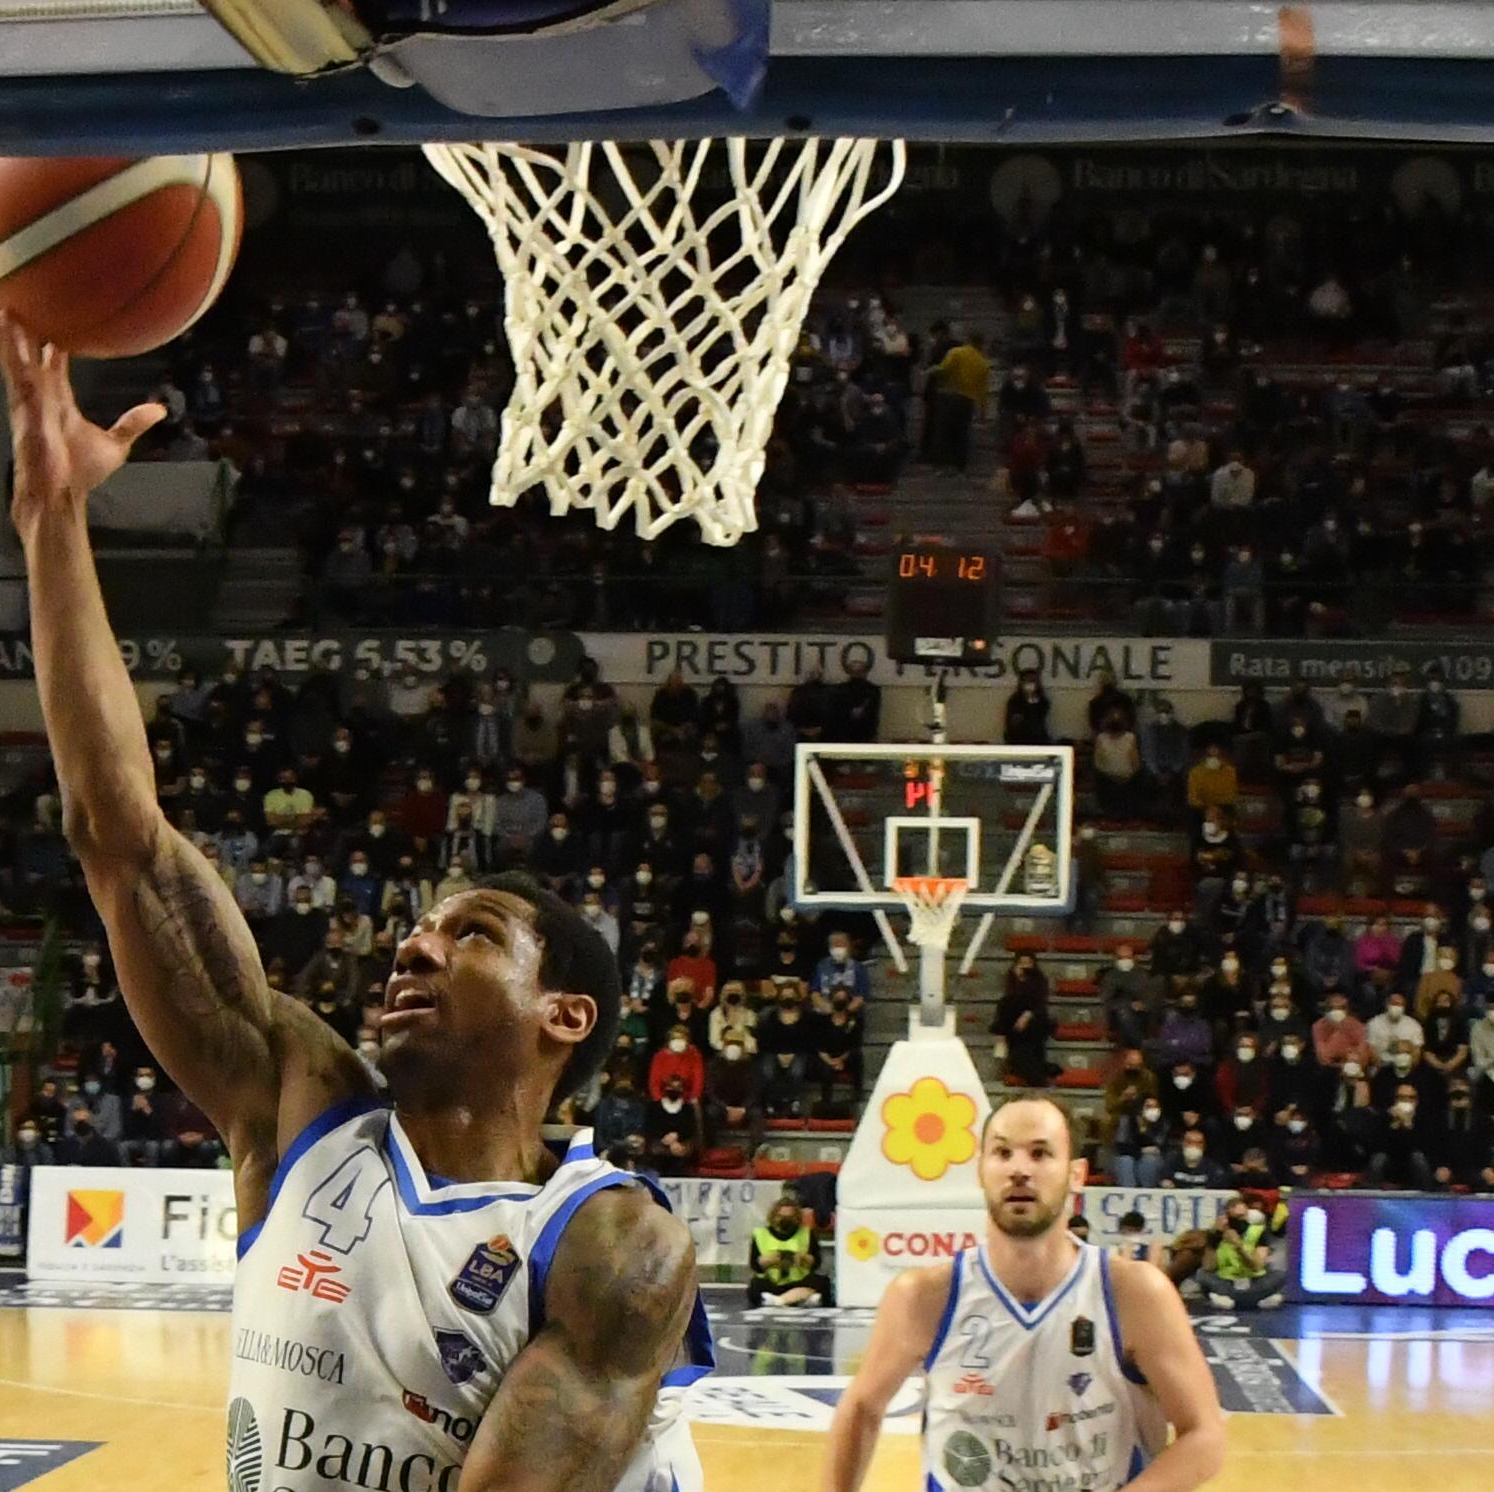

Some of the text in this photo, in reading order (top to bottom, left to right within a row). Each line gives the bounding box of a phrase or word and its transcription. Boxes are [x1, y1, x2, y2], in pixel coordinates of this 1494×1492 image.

[898, 553, 985, 580] 04 12
[119, 641, 183, 672] 9%
[224, 640, 342, 671] TAEG
[645, 640, 875, 678] PRESTITO
[893, 642, 1173, 683] SONALE
[1229, 653, 1290, 680] Rata
[301, 1145, 392, 1256] 4
